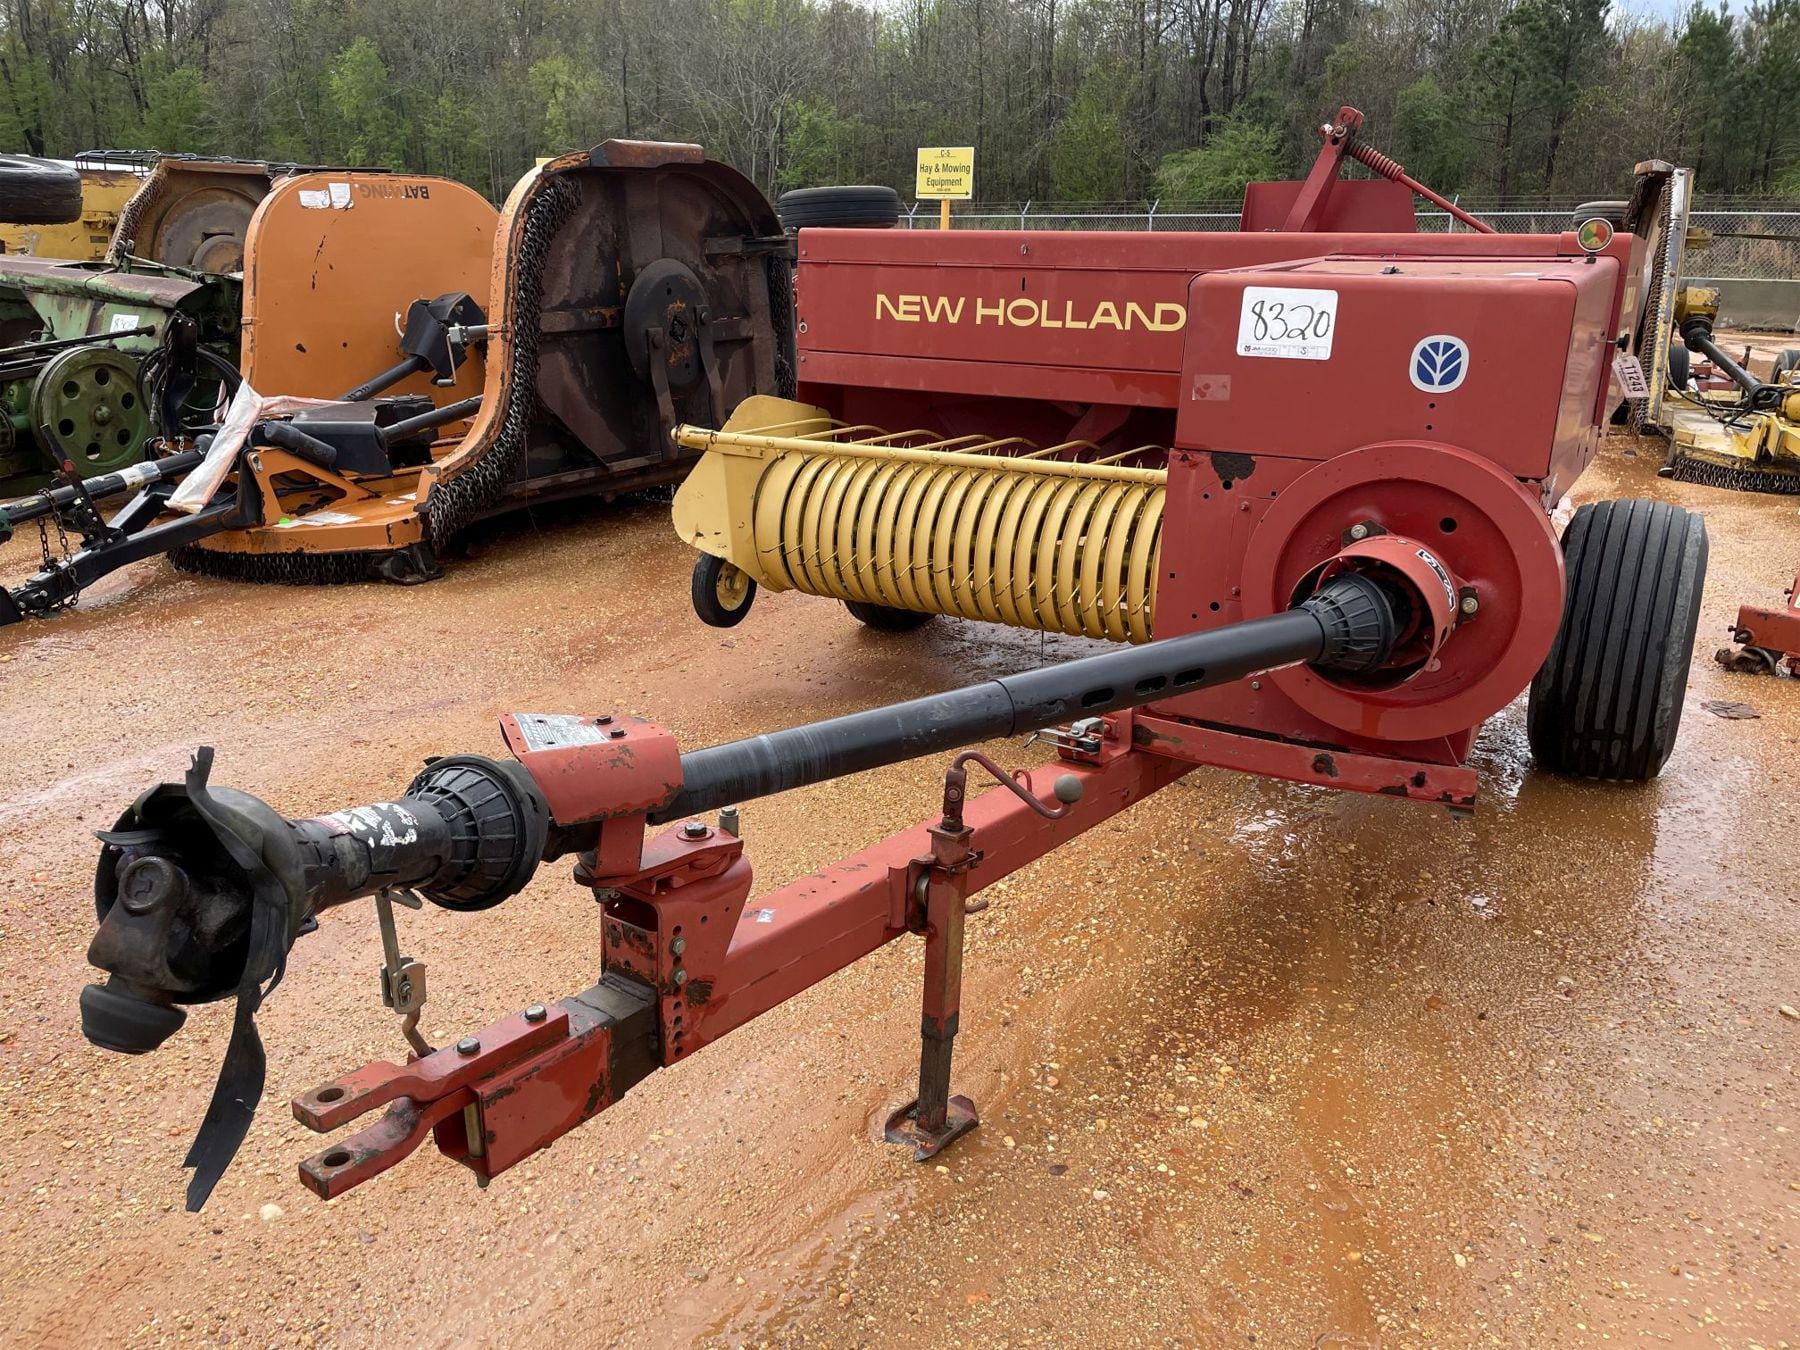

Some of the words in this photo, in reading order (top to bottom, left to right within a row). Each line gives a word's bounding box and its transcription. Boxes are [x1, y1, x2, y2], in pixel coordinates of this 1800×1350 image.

[919, 164, 932, 175] Hay
[935, 163, 940, 173] &
[942, 162, 970, 175] Mowing
[927, 177, 962, 188] Equipment
[875, 294, 965, 323] NEW
[975, 297, 1187, 332] HOLLAND
[1251, 300, 1330, 341] 8320
[1625, 365, 1644, 392] 11243
